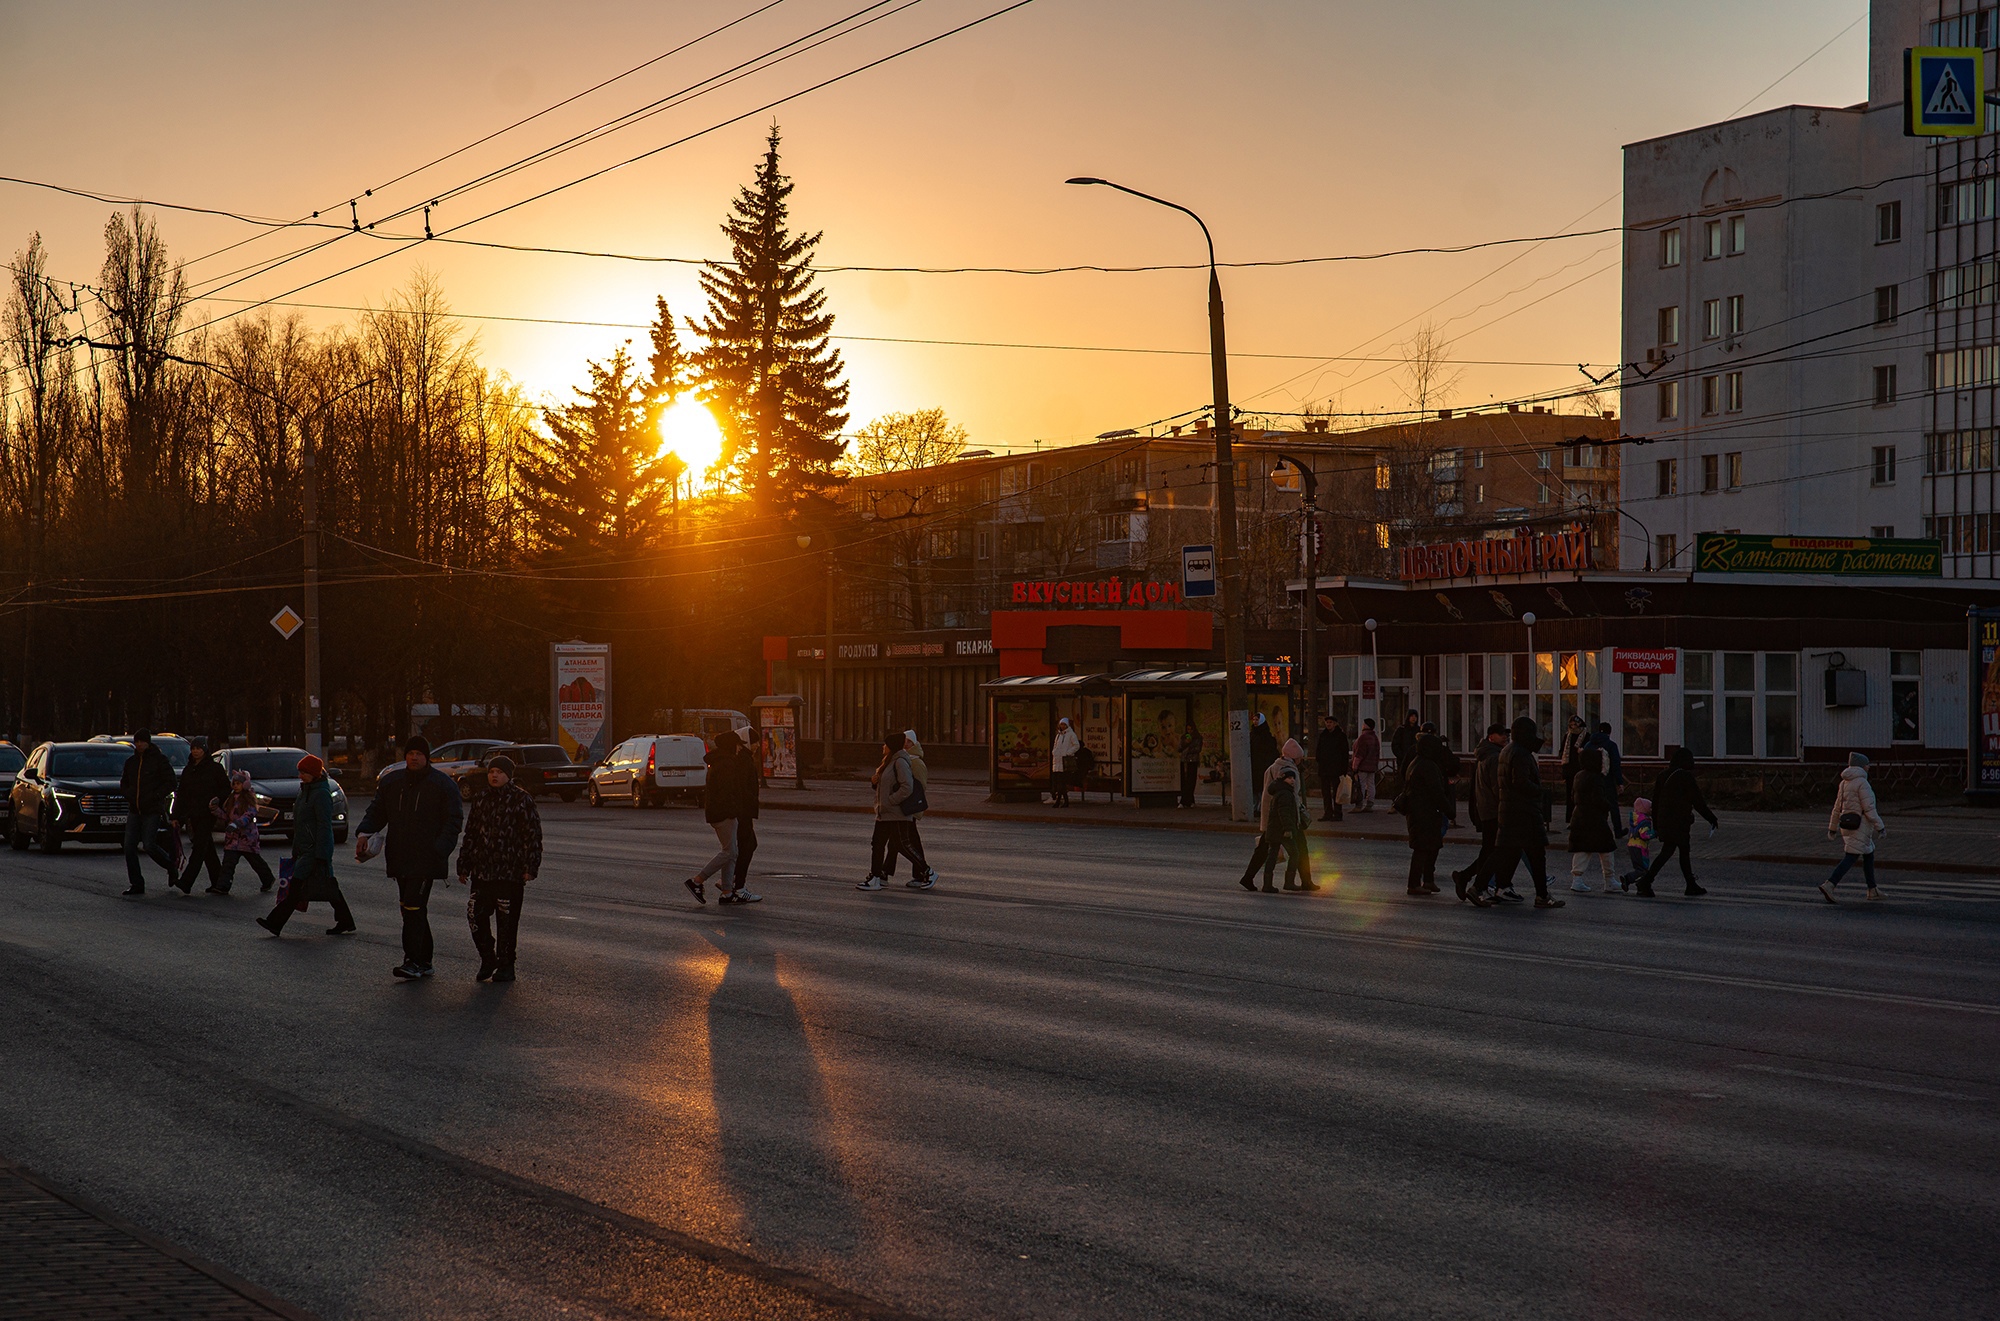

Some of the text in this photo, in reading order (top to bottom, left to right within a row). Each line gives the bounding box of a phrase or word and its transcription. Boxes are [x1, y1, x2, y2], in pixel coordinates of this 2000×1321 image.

[1789, 538, 1854, 549] ПОДАРКИ
[1399, 520, 1592, 581] ЦВЕТОЧНЫЙ РАЙ
[1702, 537, 1935, 573] Комнатные растения
[1011, 575, 1184, 608] ВКУСНЫЙ ДОМ
[838, 643, 879, 659] ПРОДУКТЫ
[956, 640, 994, 655] ПЕКАРНЯ
[1615, 651, 1675, 662] ЛИКВИДАЦИЯ
[1628, 661, 1663, 670] ТОВАРА
[561, 703, 603, 712] ВЕЩЕВАЯ
[561, 711, 603, 720] ЯРМАРКА
